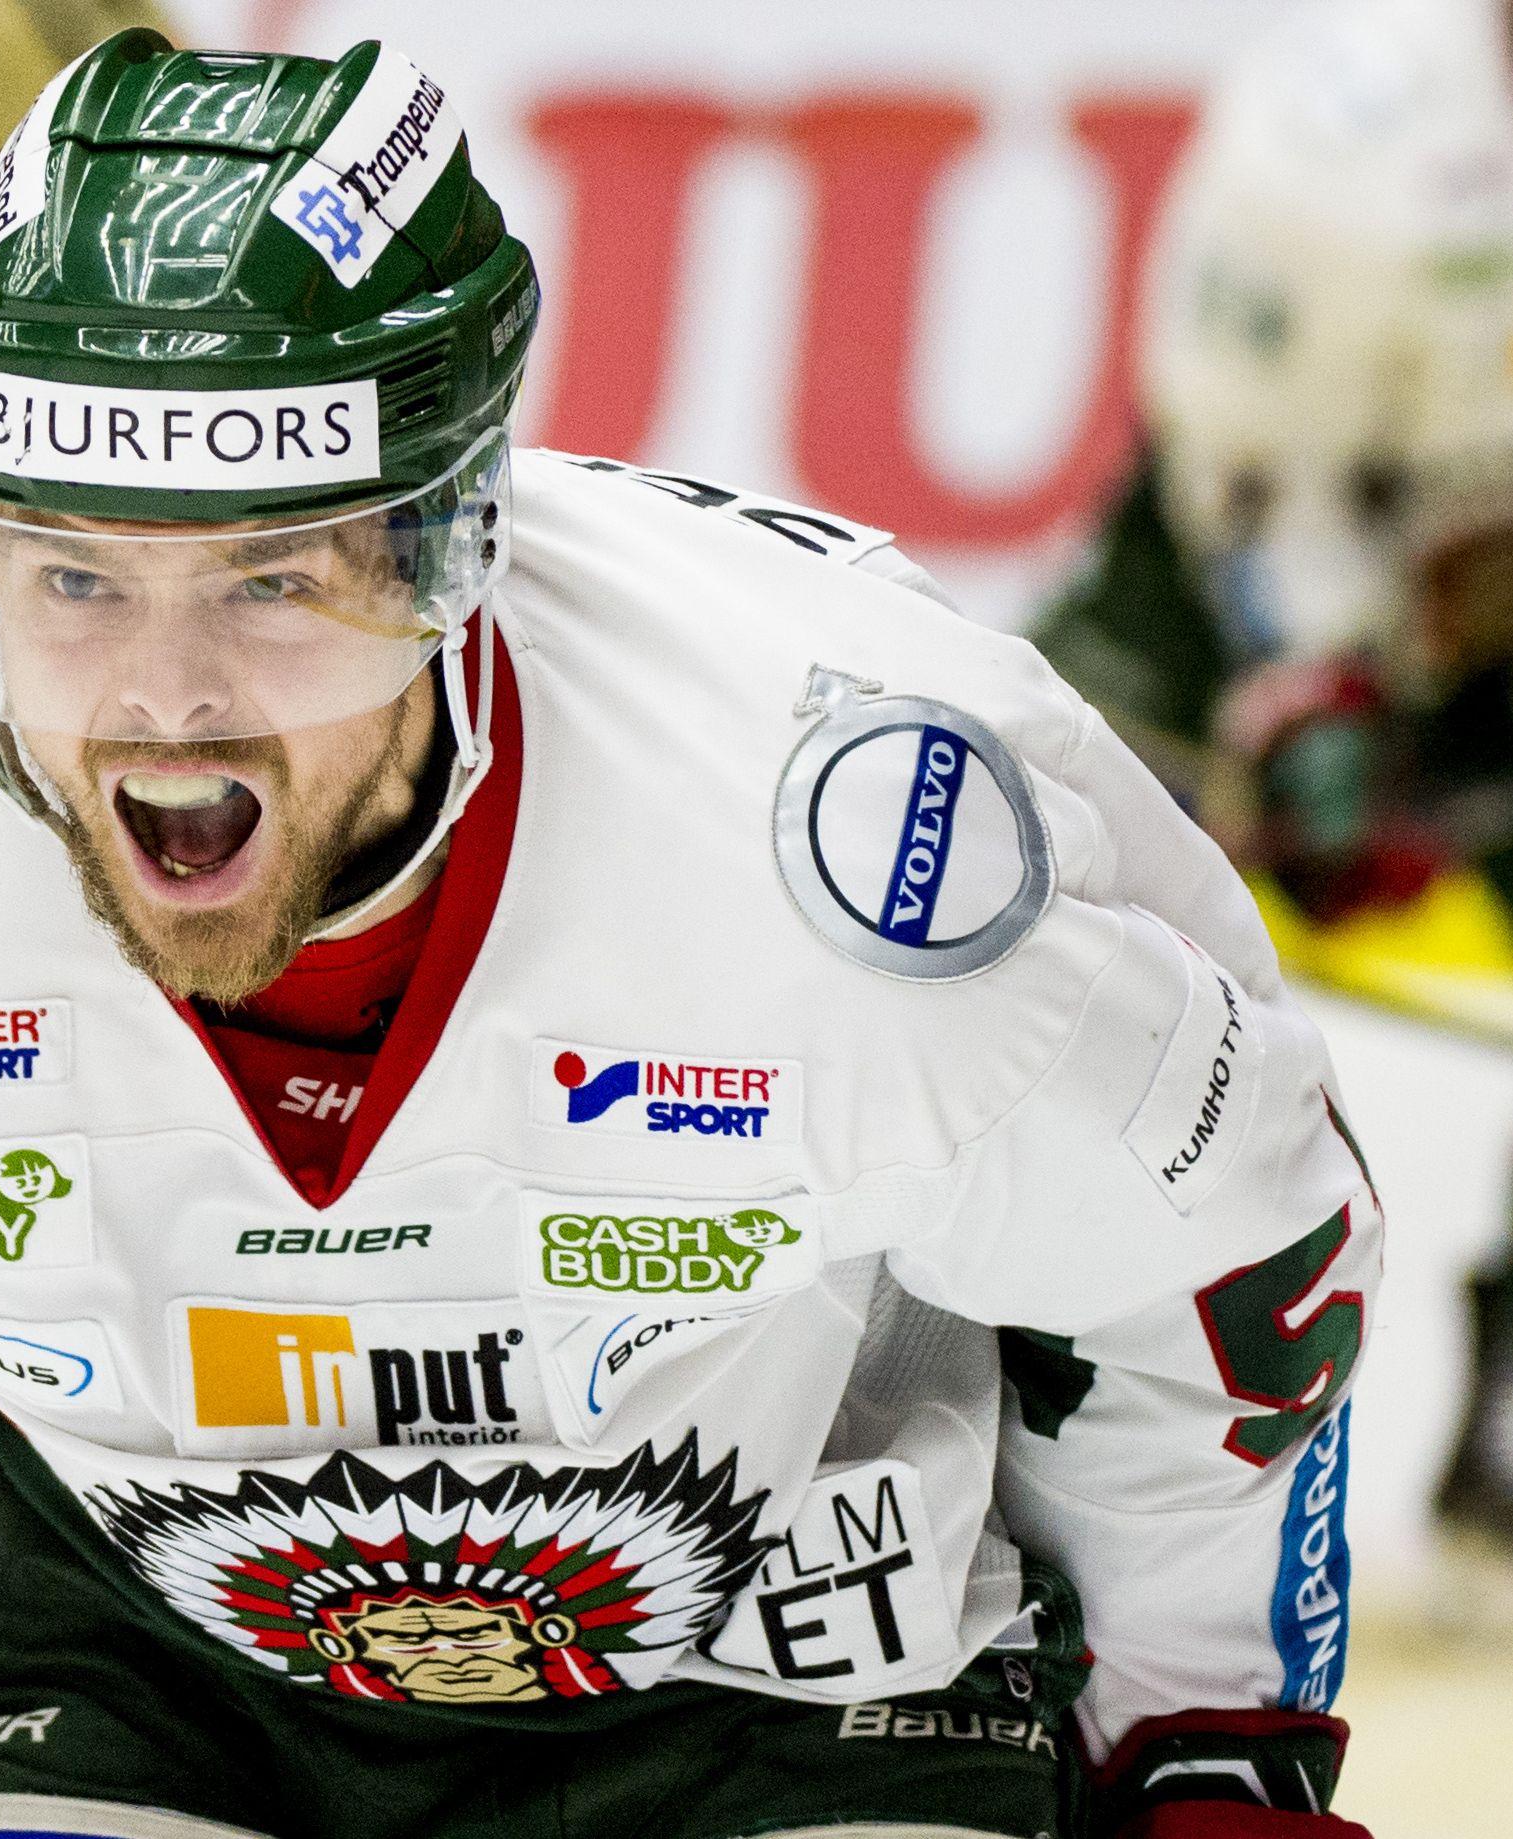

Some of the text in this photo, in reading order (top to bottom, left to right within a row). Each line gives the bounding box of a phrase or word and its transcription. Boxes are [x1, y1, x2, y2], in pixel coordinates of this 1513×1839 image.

[337, 64, 445, 213] Tranpena
[891, 741, 957, 930] VOLVO
[646, 1062, 770, 1102] INTER
[646, 1103, 770, 1138] SPORT
[1162, 1058, 1230, 1184] KUMHO
[548, 1217, 710, 1254] CASH
[548, 1253, 757, 1289] BUDDY
